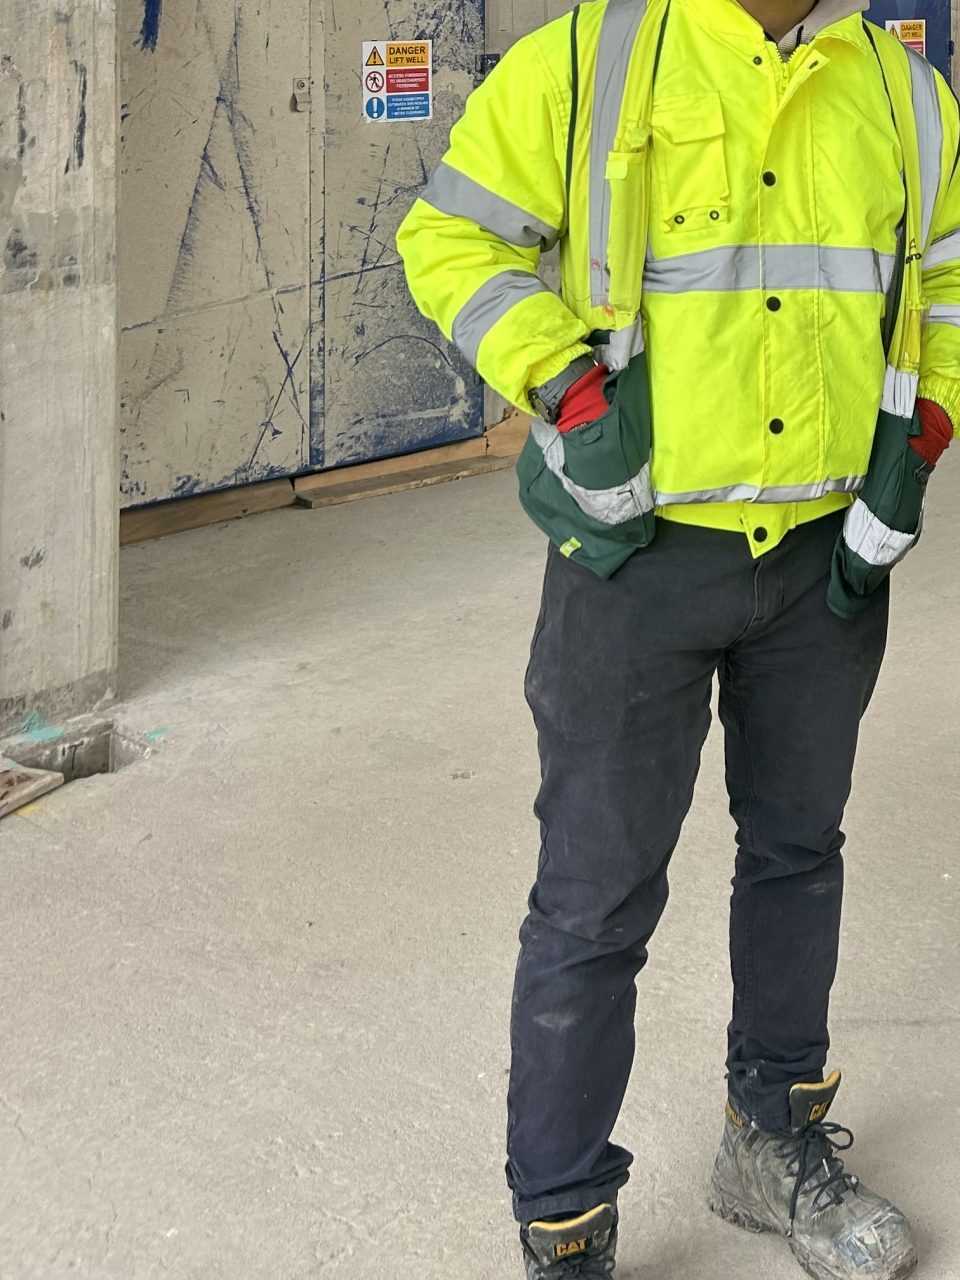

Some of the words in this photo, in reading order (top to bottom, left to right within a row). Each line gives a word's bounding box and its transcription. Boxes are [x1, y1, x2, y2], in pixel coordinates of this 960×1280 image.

[389, 46, 426, 55] DANGER
[389, 56, 404, 64] LIFT
[556, 1237, 587, 1257] CAT
